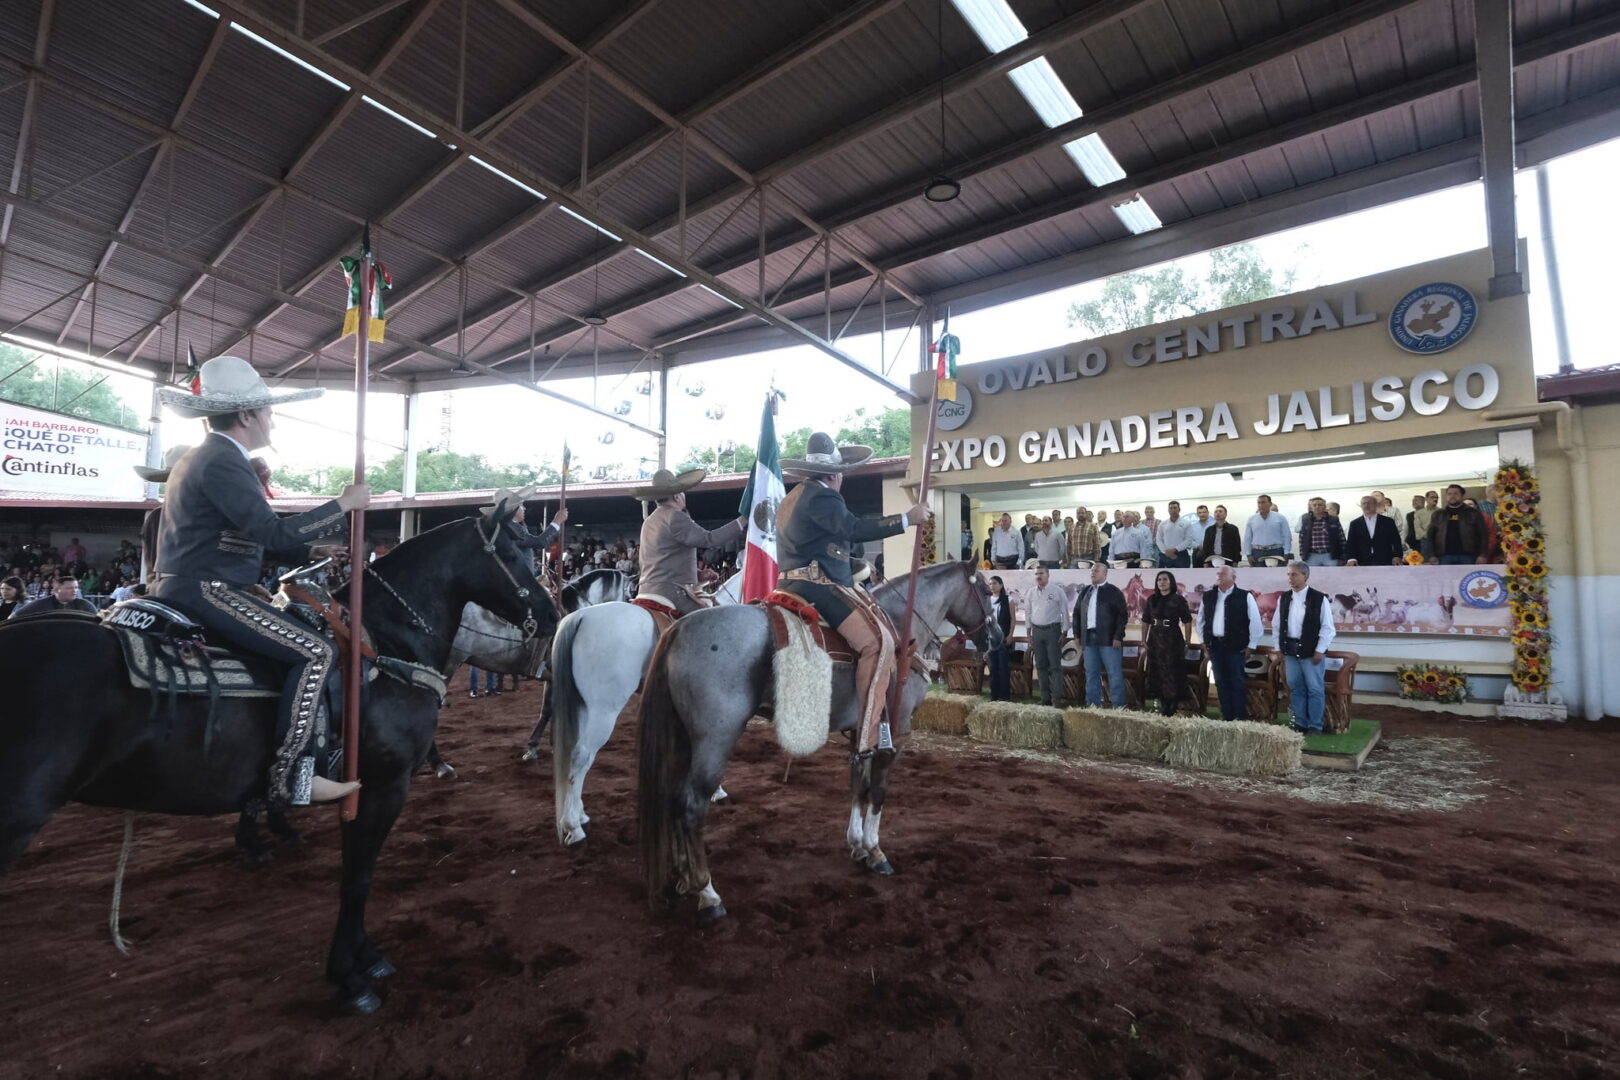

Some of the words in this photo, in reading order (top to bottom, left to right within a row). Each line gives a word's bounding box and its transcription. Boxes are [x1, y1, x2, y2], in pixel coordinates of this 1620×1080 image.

[978, 347, 1107, 394] OVALO
[1123, 291, 1377, 367] CENTRAL
[5, 418, 29, 427] ¡AH
[944, 407, 965, 417] CNG
[1018, 401, 1240, 464] GANADERA
[1253, 363, 1499, 436] JALISCO
[4, 439, 75, 454] CHATO!
[5, 427, 53, 441] ¡QUÉ
[58, 433, 142, 451] DETALLE,
[2, 456, 99, 478] Cantinflas
[111, 608, 156, 629] JALISCO
